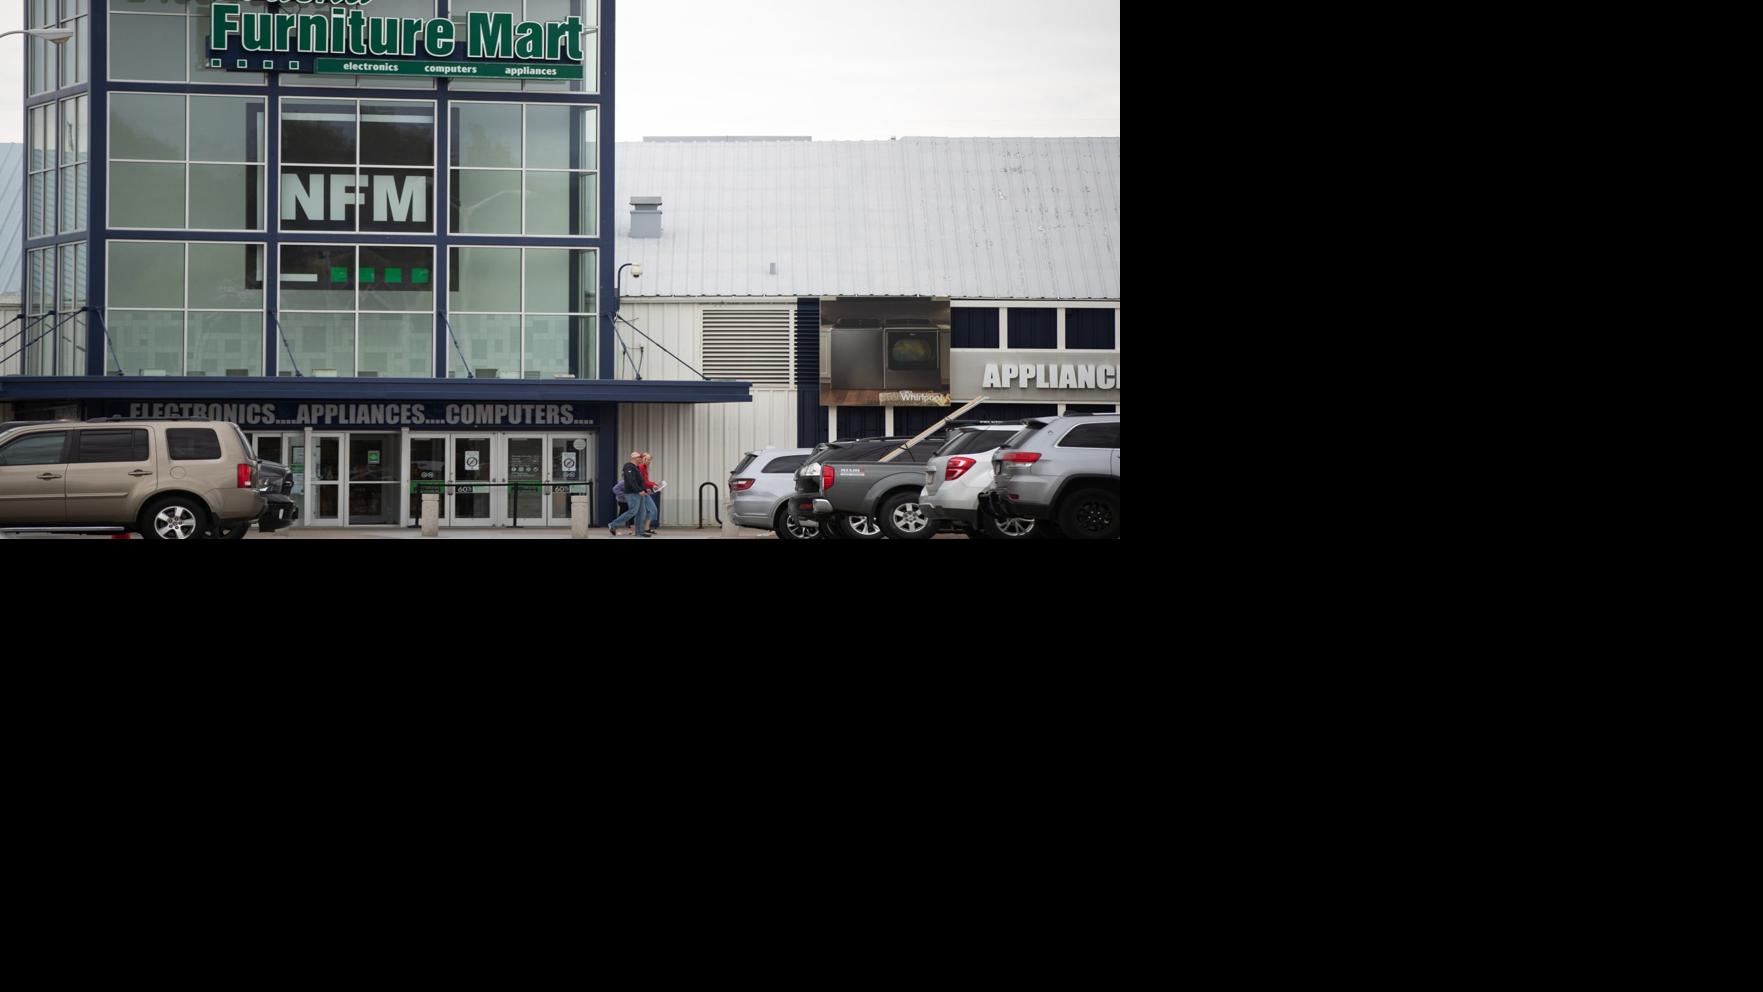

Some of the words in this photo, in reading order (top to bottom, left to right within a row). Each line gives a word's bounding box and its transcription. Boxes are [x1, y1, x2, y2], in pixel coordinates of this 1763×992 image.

[210, 3, 456, 57] Furniture
[466, 11, 584, 61] Mart
[343, 62, 399, 72] electronics
[424, 64, 477, 75] computers
[504, 66, 557, 76] appliances
[280, 173, 427, 223] NFM
[982, 363, 1120, 390] APPLIANC
